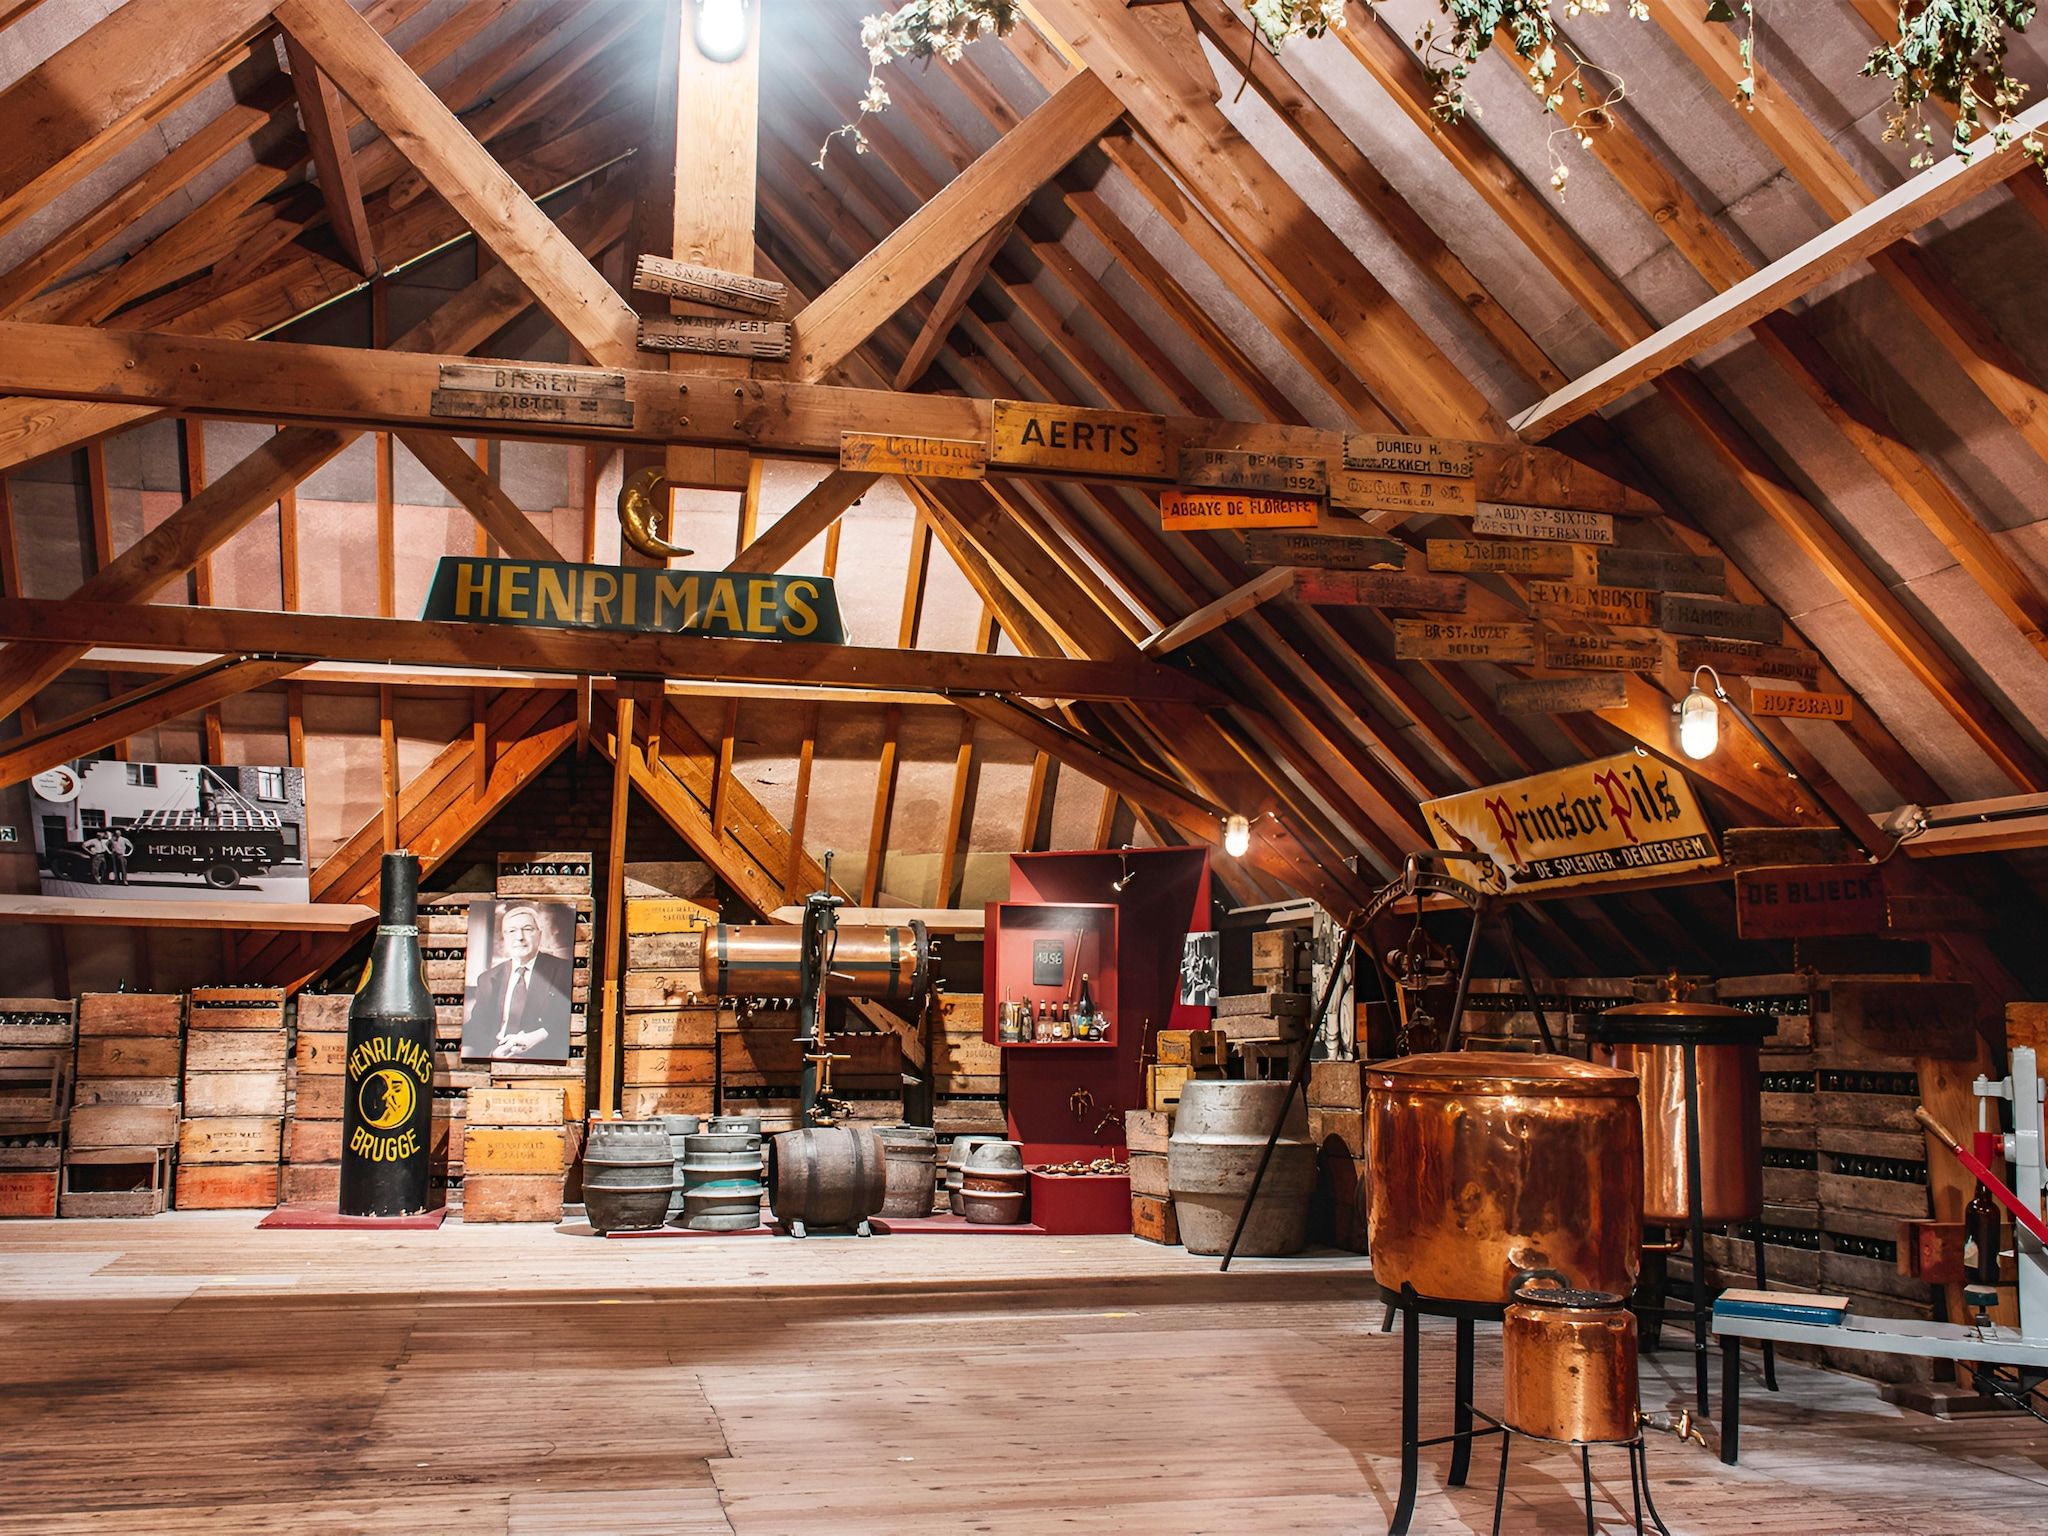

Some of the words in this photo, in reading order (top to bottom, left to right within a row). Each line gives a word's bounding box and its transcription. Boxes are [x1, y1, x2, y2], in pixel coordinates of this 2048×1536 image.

[1020, 417, 1140, 456] AERTS
[1376, 440, 1423, 455] DURIEU
[1205, 452, 1229, 465] BR.
[1248, 454, 1305, 470] DEMETS
[1381, 458, 1431, 472] REKKEM
[1283, 476, 1316, 490] 1952
[1171, 502, 1223, 516] ABBAYE
[1227, 501, 1244, 515] DE
[1250, 501, 1312, 515] FLOREFFE
[453, 561, 638, 626] HENRI
[654, 573, 819, 637] MAES
[1484, 794, 1609, 875] Prinsor
[1593, 763, 1682, 845] Pils
[148, 844, 198, 856] HENRI
[222, 845, 268, 858] MAES
[1535, 861, 1554, 880] DE
[1624, 836, 1708, 867] DENTERGEM
[1747, 882, 1780, 906] DE
[1786, 879, 1873, 903] BLIECK
[348, 1036, 392, 1083] HENRI
[395, 1036, 433, 1085] MAES
[350, 1125, 421, 1162] BRUGGE
